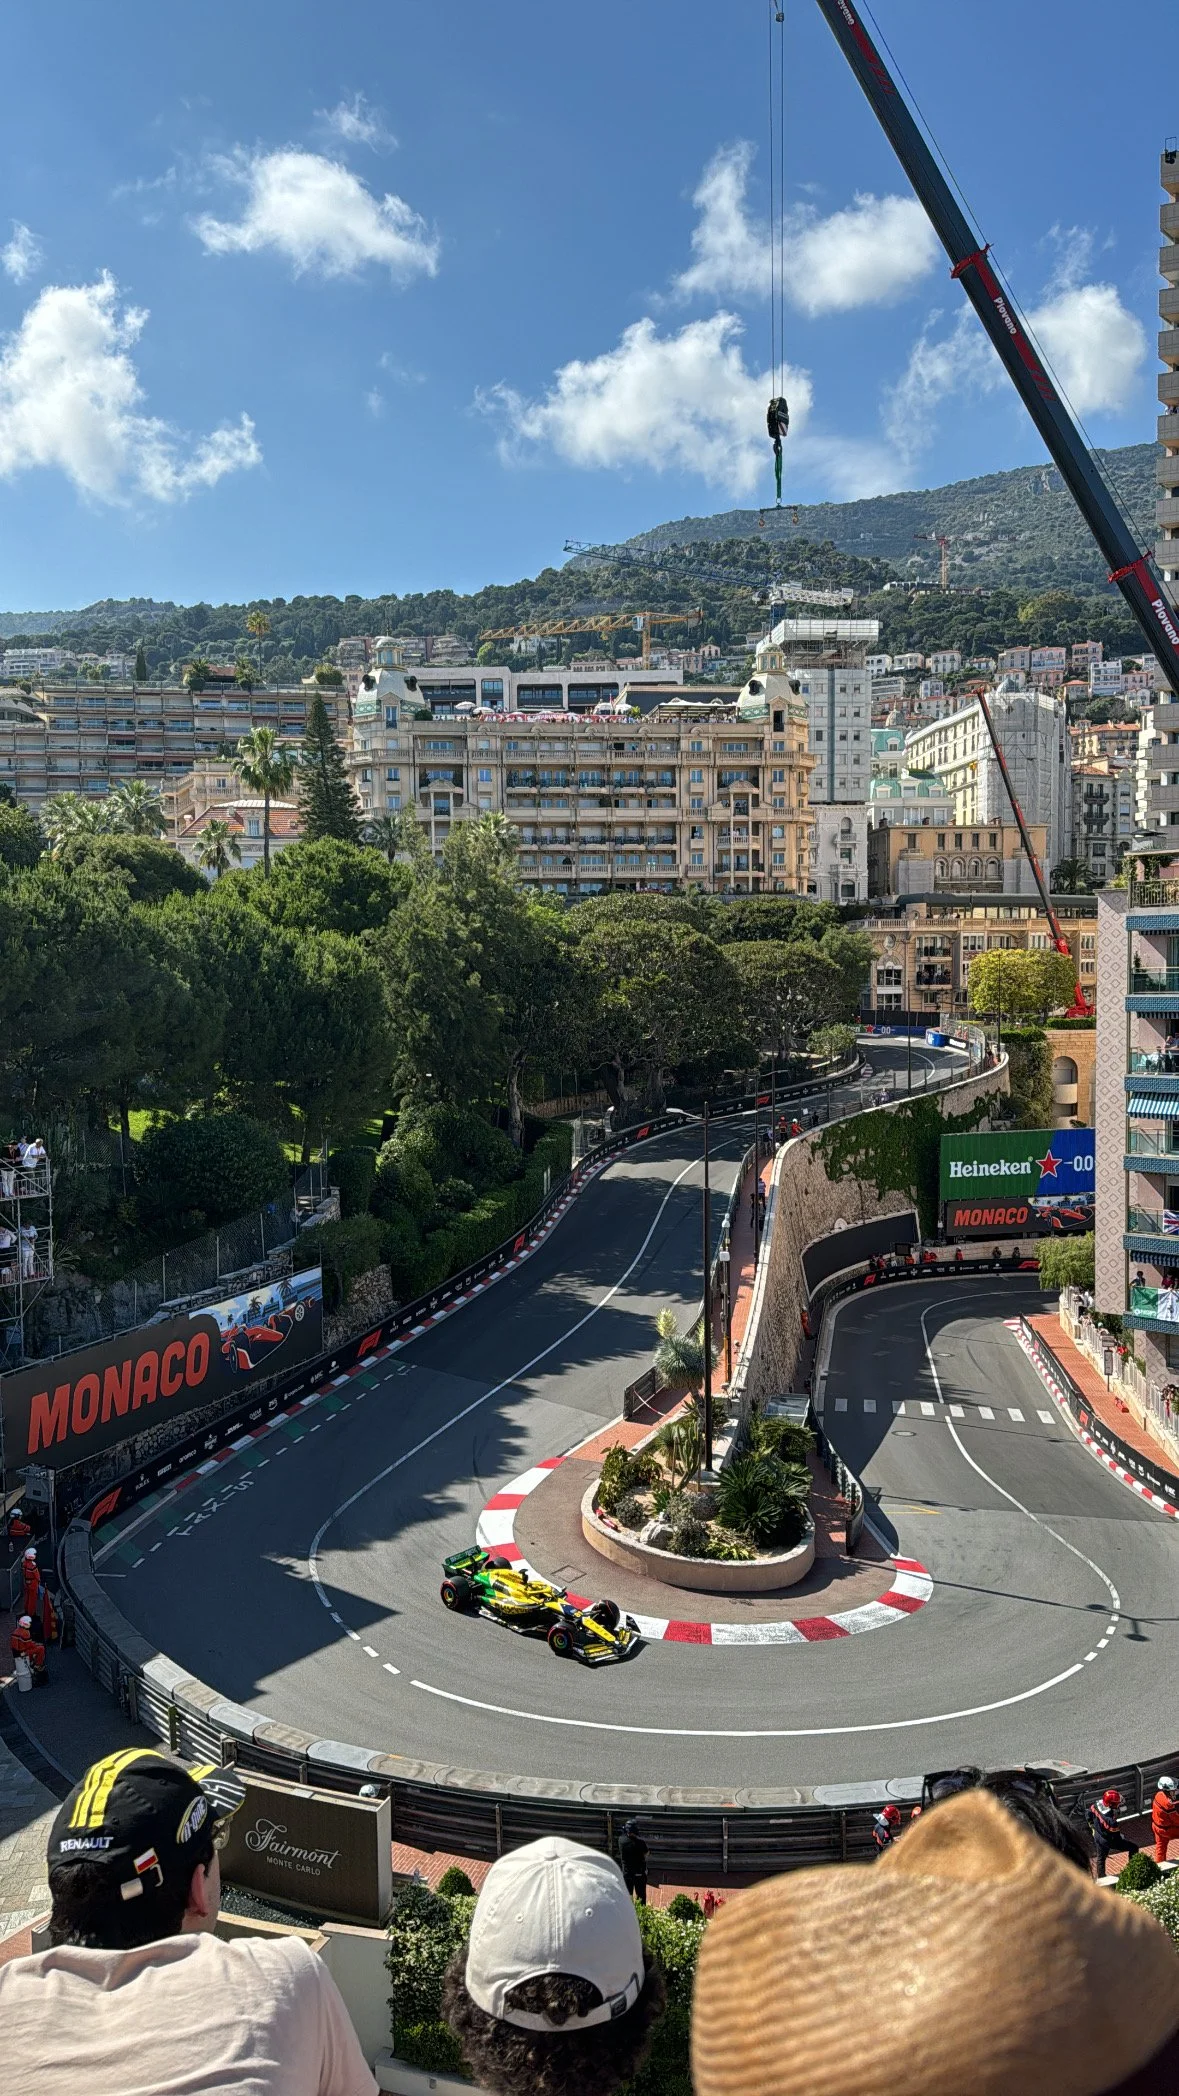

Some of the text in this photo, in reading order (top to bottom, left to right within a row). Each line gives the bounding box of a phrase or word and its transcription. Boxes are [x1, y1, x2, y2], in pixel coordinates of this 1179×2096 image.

[994, 297, 1017, 334] Piovano
[1152, 599, 1179, 645] Piovano
[949, 1159, 1032, 1178] Heineken
[954, 1207, 1028, 1226] MONACO
[28, 1332, 210, 1455] MONACO
[176, 1481, 254, 1536] TAXIS
[60, 1836, 114, 1852] RENAULT
[245, 1818, 342, 1869] Fairmont
[266, 1856, 321, 1876] MONTE CARLO
